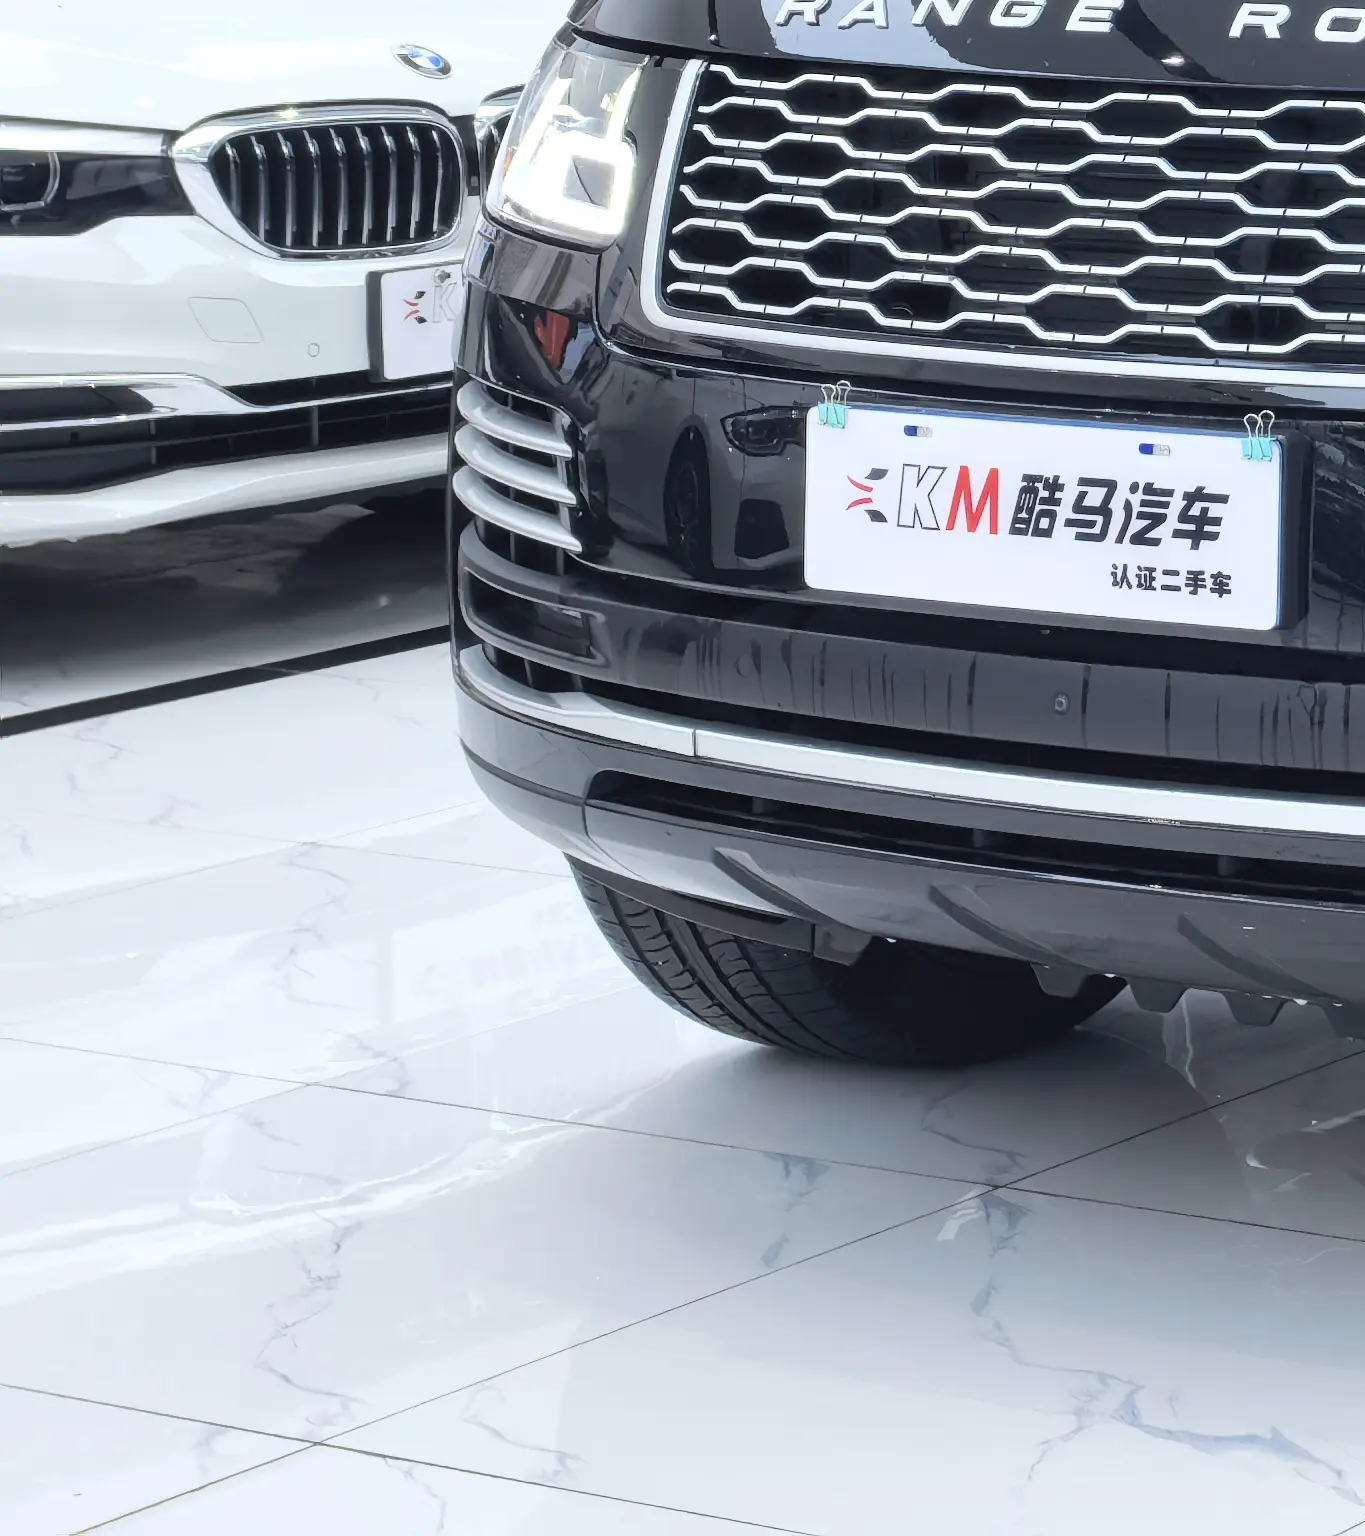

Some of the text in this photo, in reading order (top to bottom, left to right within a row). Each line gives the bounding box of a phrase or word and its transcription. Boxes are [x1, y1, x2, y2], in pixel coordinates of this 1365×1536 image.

[896, 464, 1231, 551] KM 酷马汽车
[1110, 563, 1232, 599] 认证二手车
